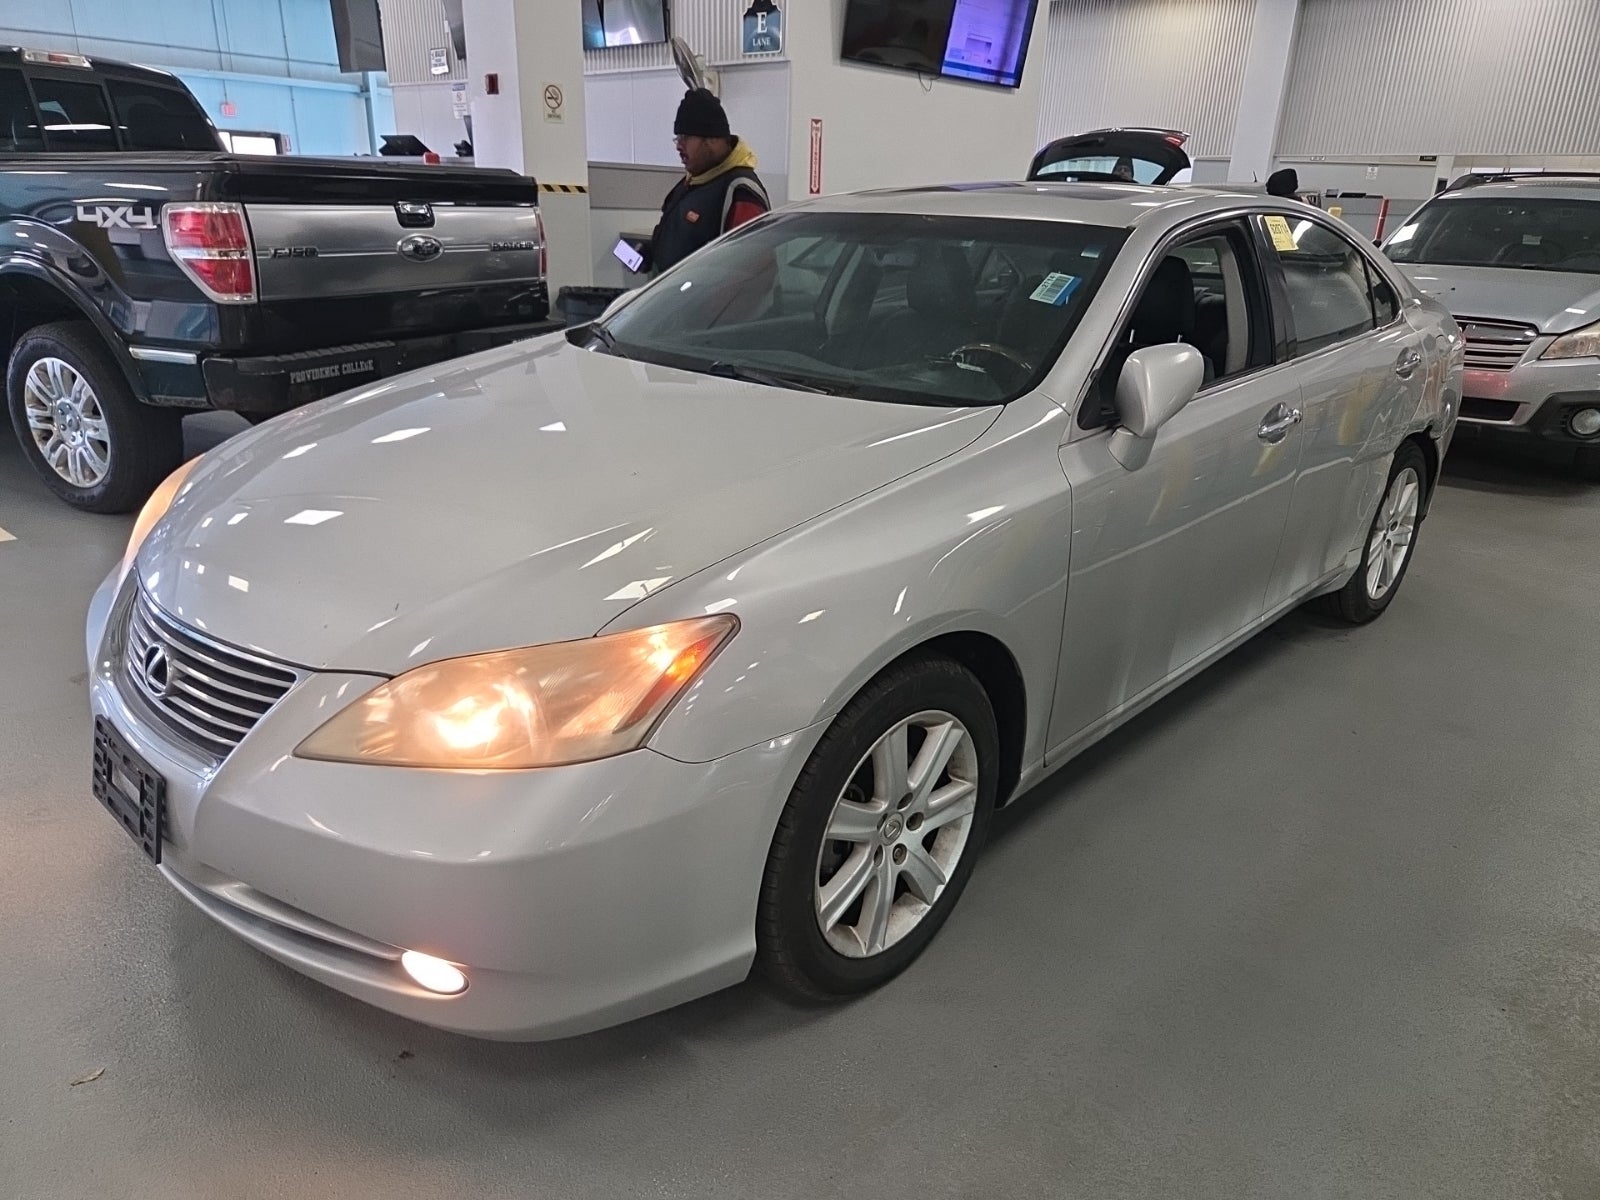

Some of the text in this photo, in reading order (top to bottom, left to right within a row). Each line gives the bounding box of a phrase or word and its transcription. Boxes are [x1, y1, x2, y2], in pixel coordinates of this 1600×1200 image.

[756, 11, 768, 34] E
[752, 37, 771, 47] LANE
[341, 359, 375, 375] COLLEGE
